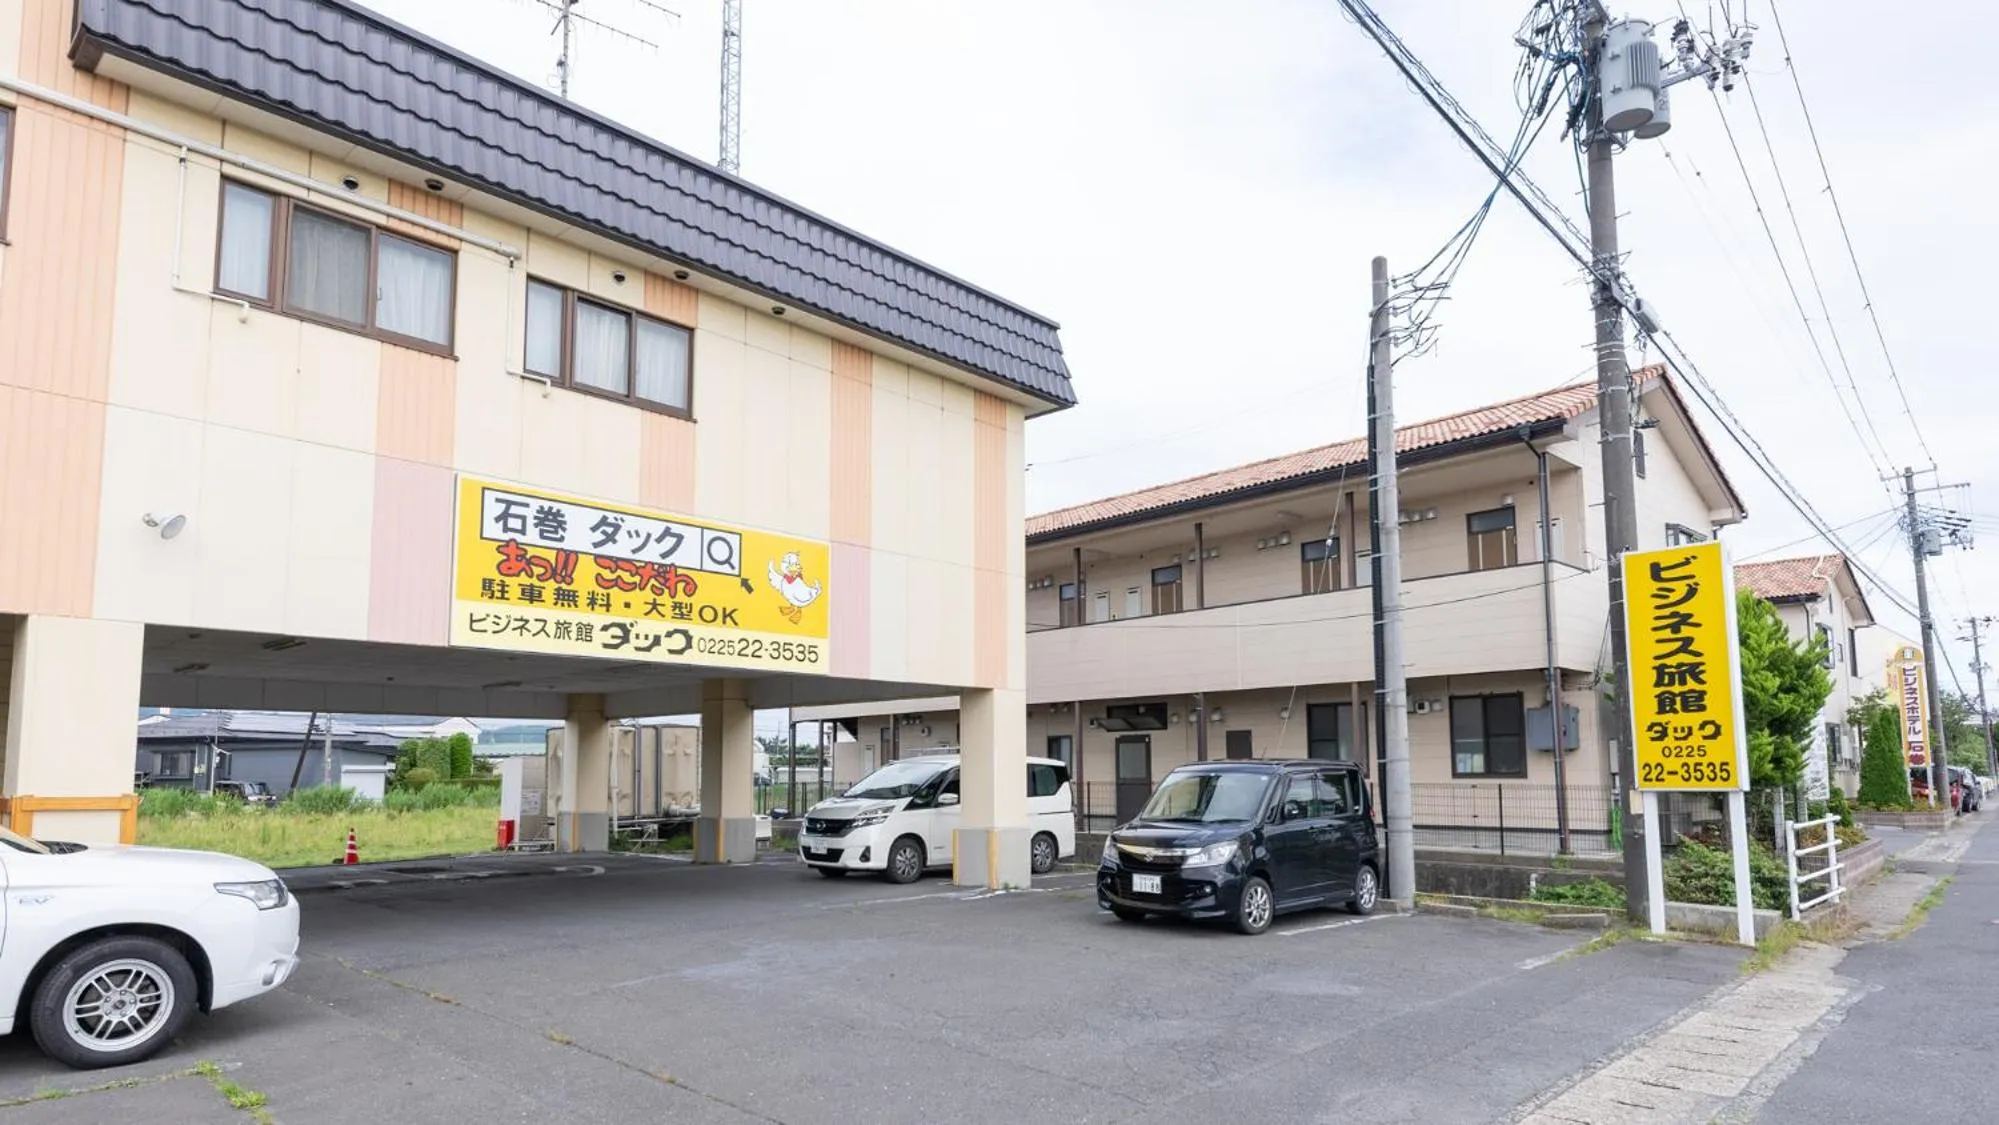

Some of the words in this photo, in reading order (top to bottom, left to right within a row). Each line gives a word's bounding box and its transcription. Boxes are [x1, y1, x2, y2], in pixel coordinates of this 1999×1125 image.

[494, 497, 567, 543] 石巻
[590, 513, 685, 560] ダック
[469, 612, 595, 643] ビジネス旅館
[600, 620, 694, 655] ダック
[697, 637, 736, 656] 0225
[737, 637, 820, 664] 22-3535
[1650, 555, 1708, 715] ビジネス旅館
[1646, 719, 1722, 742] ダック
[1661, 745, 1707, 759] 0225
[1642, 762, 1731, 783] 22-3535
